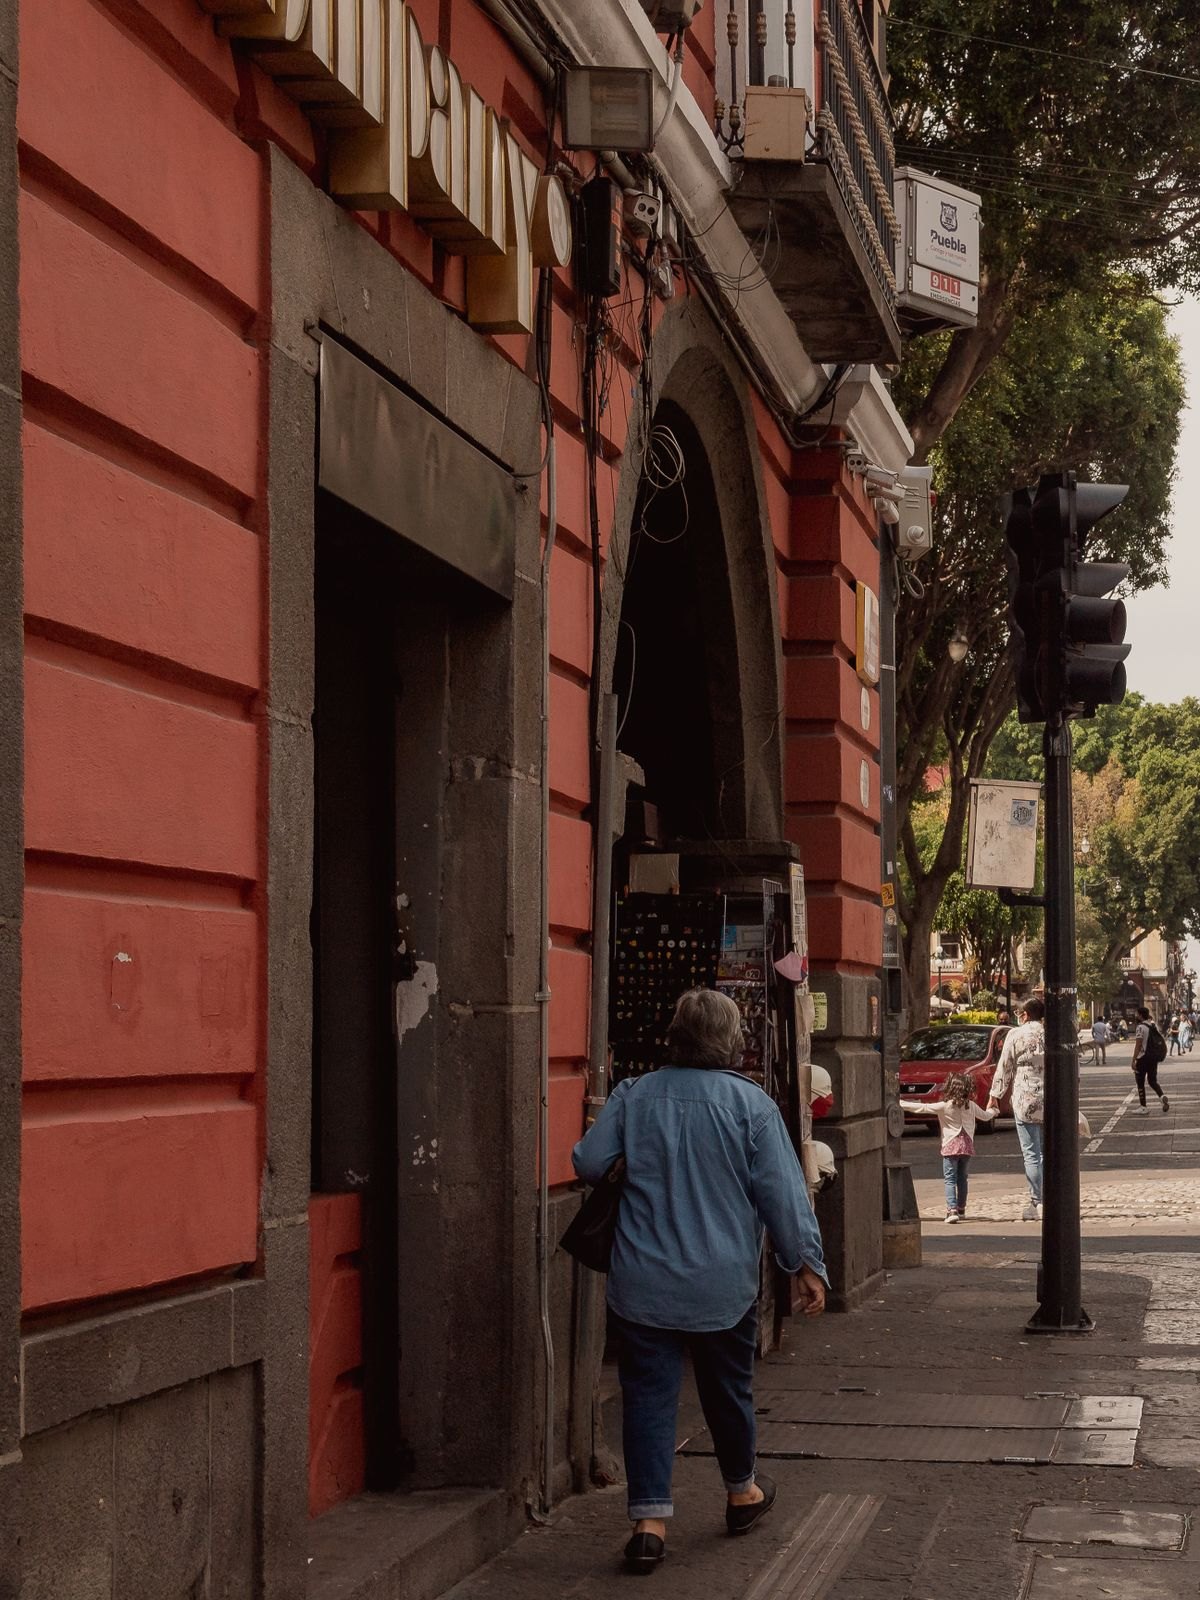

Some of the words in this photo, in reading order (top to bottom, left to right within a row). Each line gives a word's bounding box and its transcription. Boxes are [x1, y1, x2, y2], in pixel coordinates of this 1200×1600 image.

[930, 229, 966, 254] Puebla
[932, 275, 958, 294] 911
[930, 292, 960, 307] EMERGENCIAS
